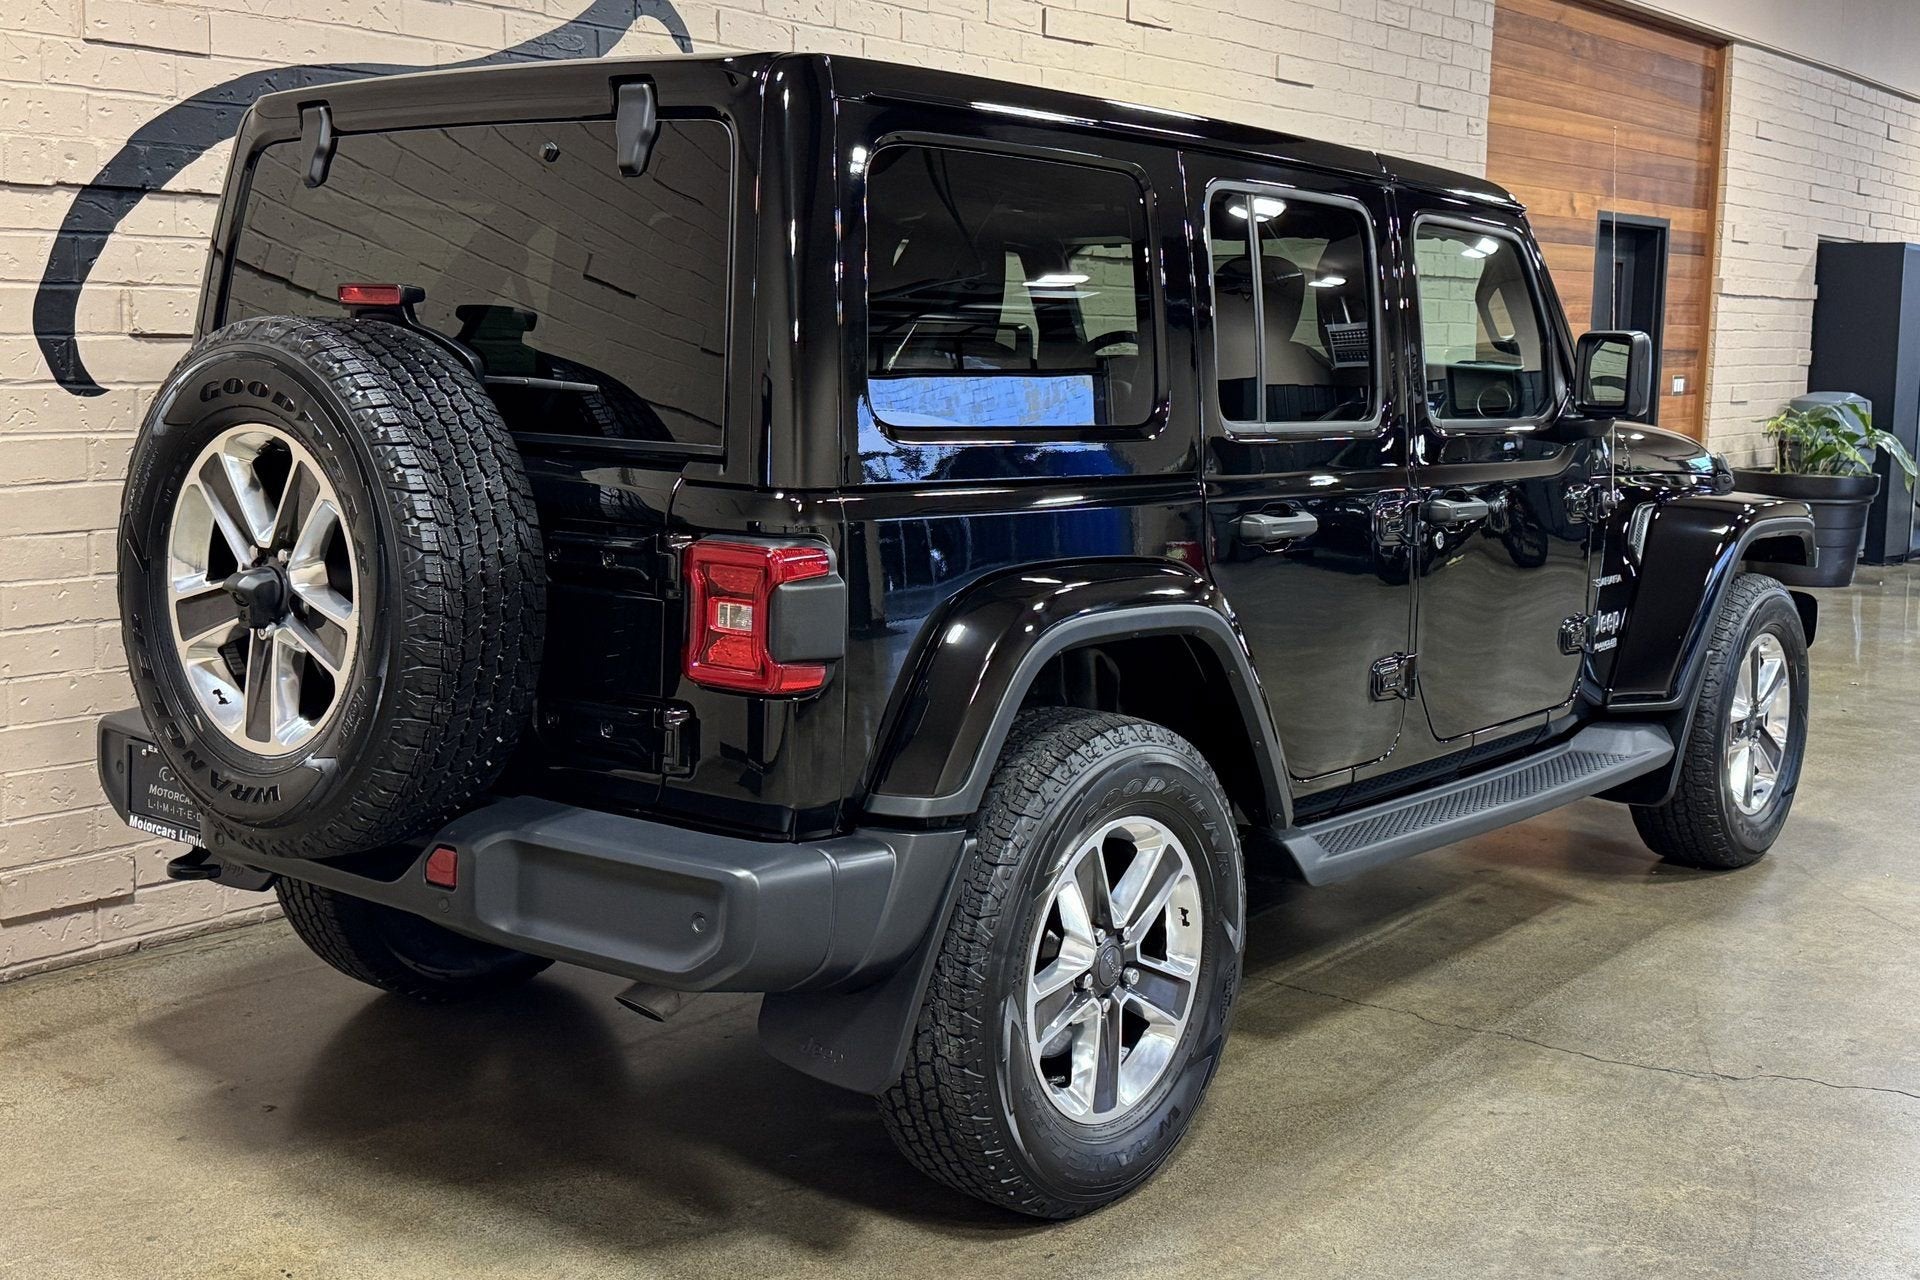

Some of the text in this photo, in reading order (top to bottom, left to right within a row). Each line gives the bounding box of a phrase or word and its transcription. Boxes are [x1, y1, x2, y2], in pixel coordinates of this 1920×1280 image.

[1595, 610, 1620, 635] Jeep
[148, 784, 193, 806] MOTORCA
[129, 814, 177, 839] Motorcars
